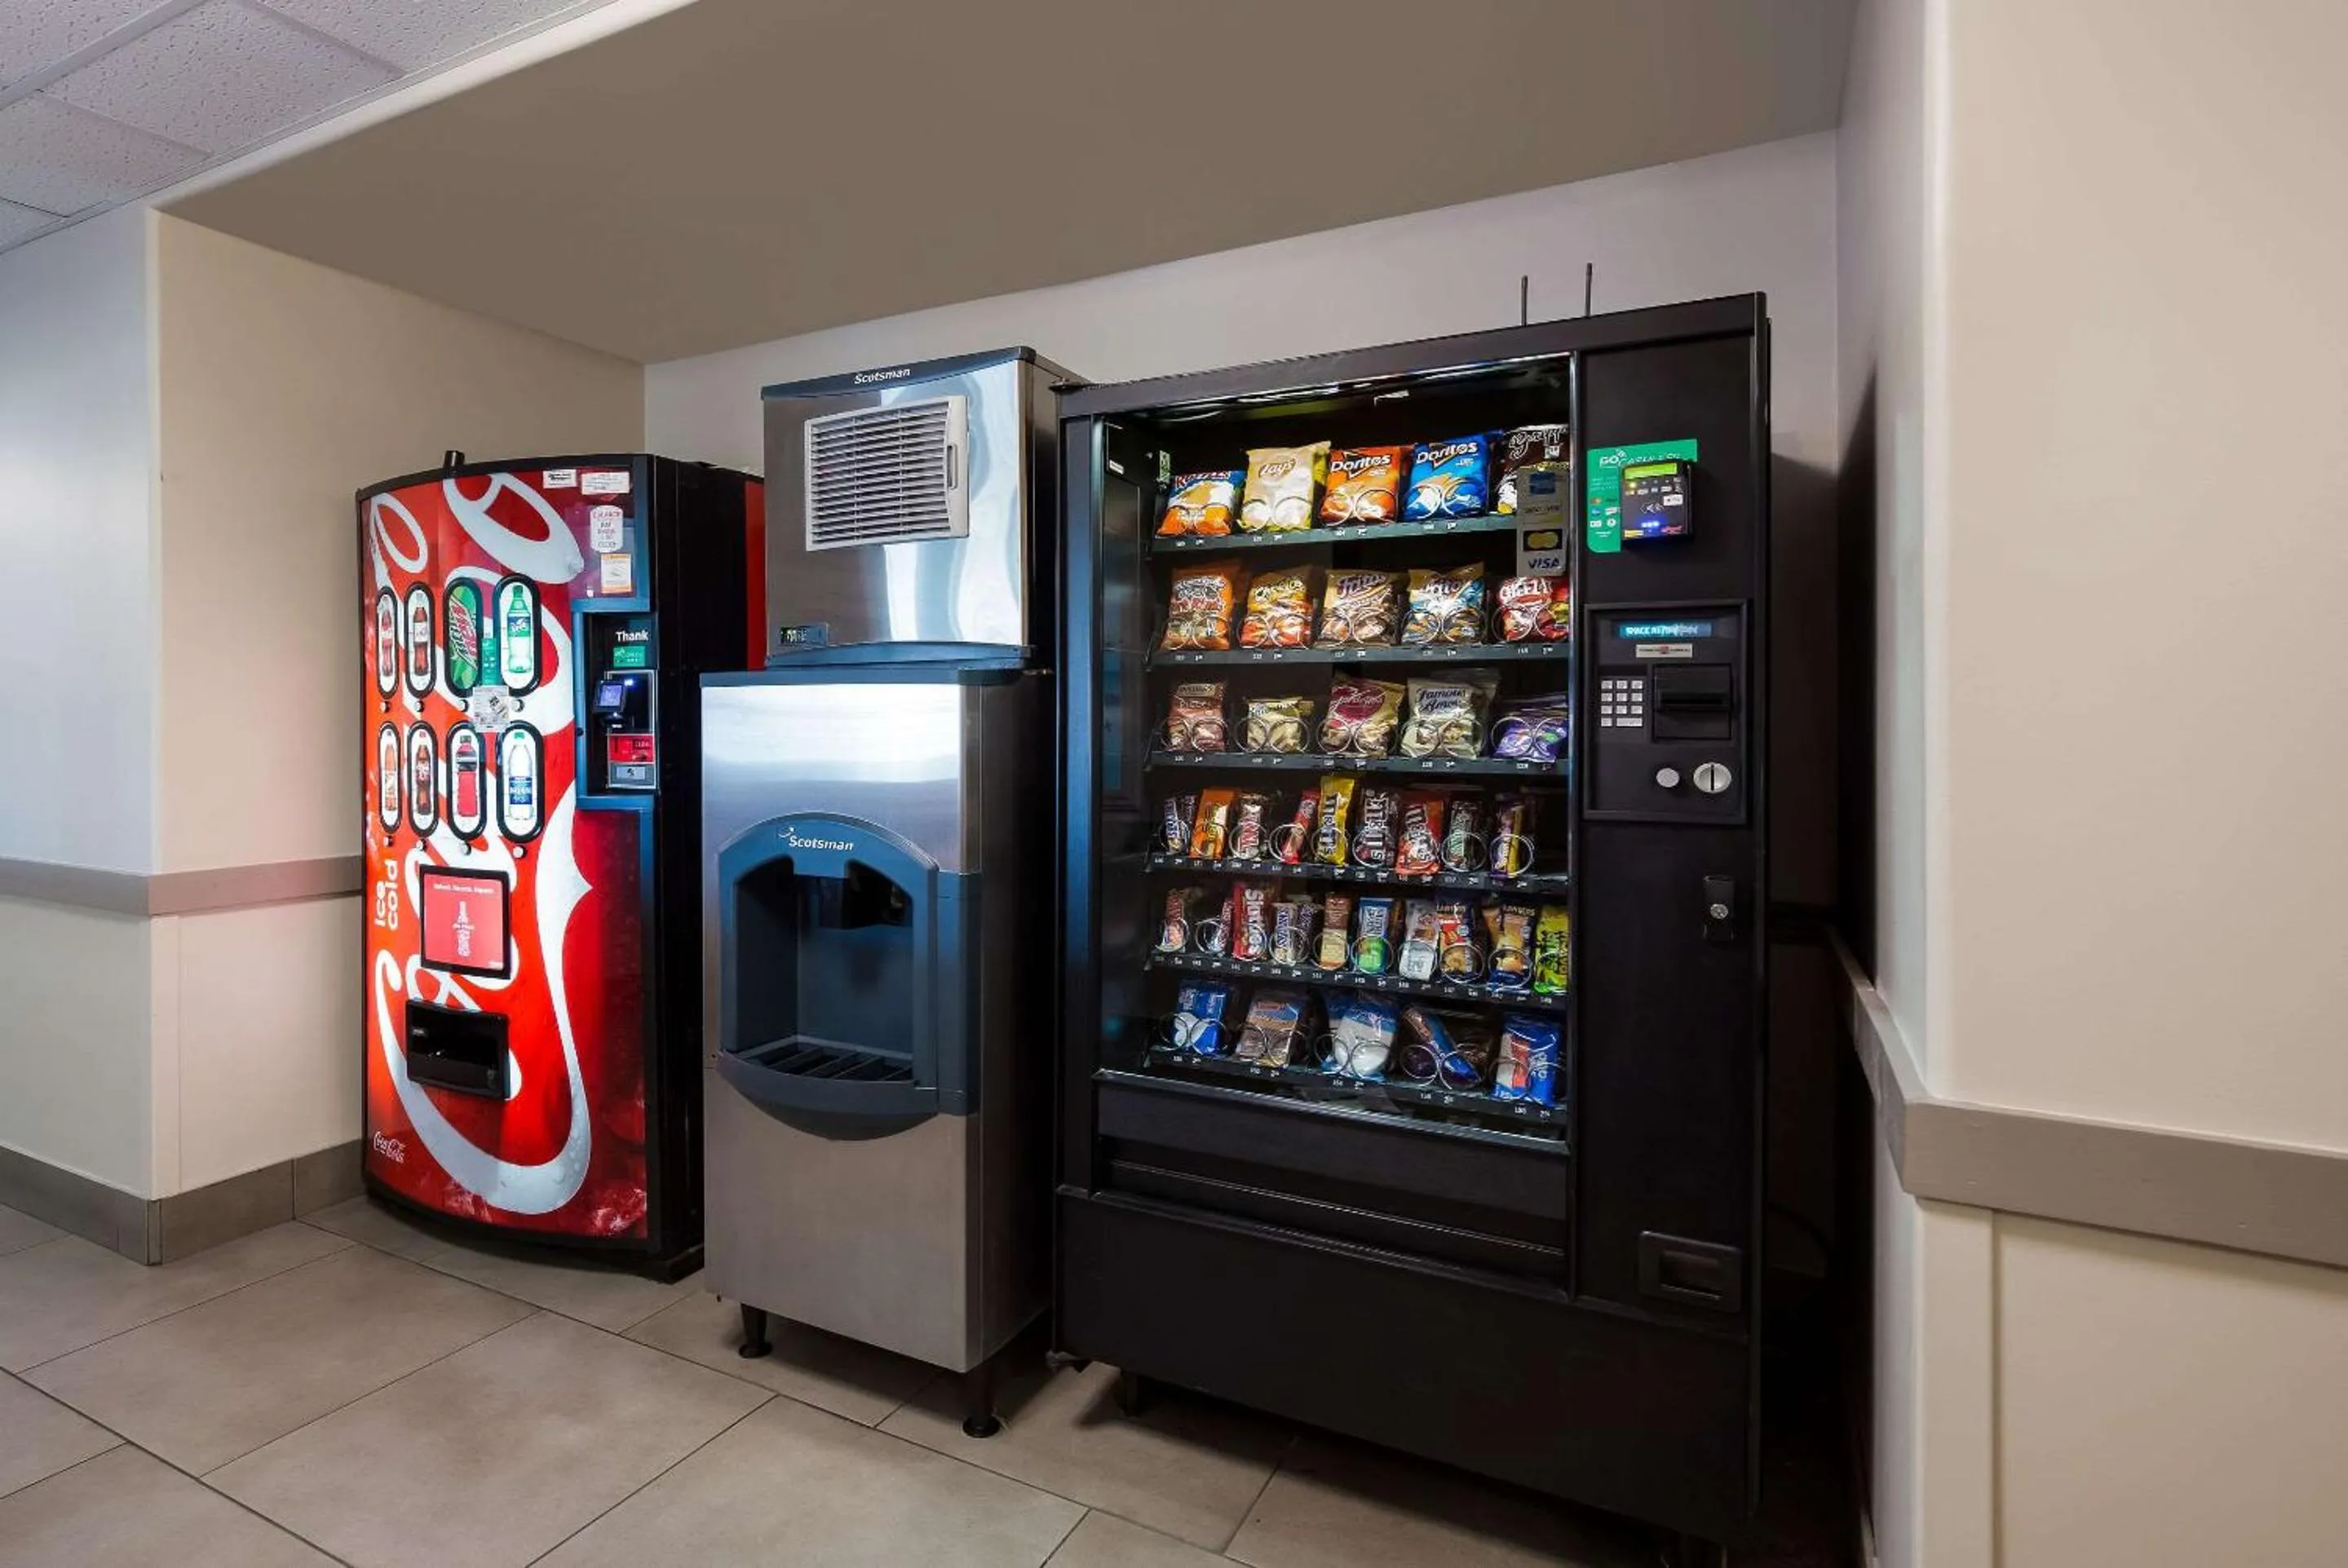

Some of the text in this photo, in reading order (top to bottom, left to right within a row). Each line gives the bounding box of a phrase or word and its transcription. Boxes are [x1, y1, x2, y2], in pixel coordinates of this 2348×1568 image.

[854, 369, 911, 384] Scotsman
[1416, 441, 1478, 464] Doritos
[1330, 453, 1391, 473] Doritos
[1528, 557, 1560, 569] VISA
[616, 629, 649, 643] Thank
[788, 835, 854, 851] Scotsman
[385, 859, 398, 930] cold
